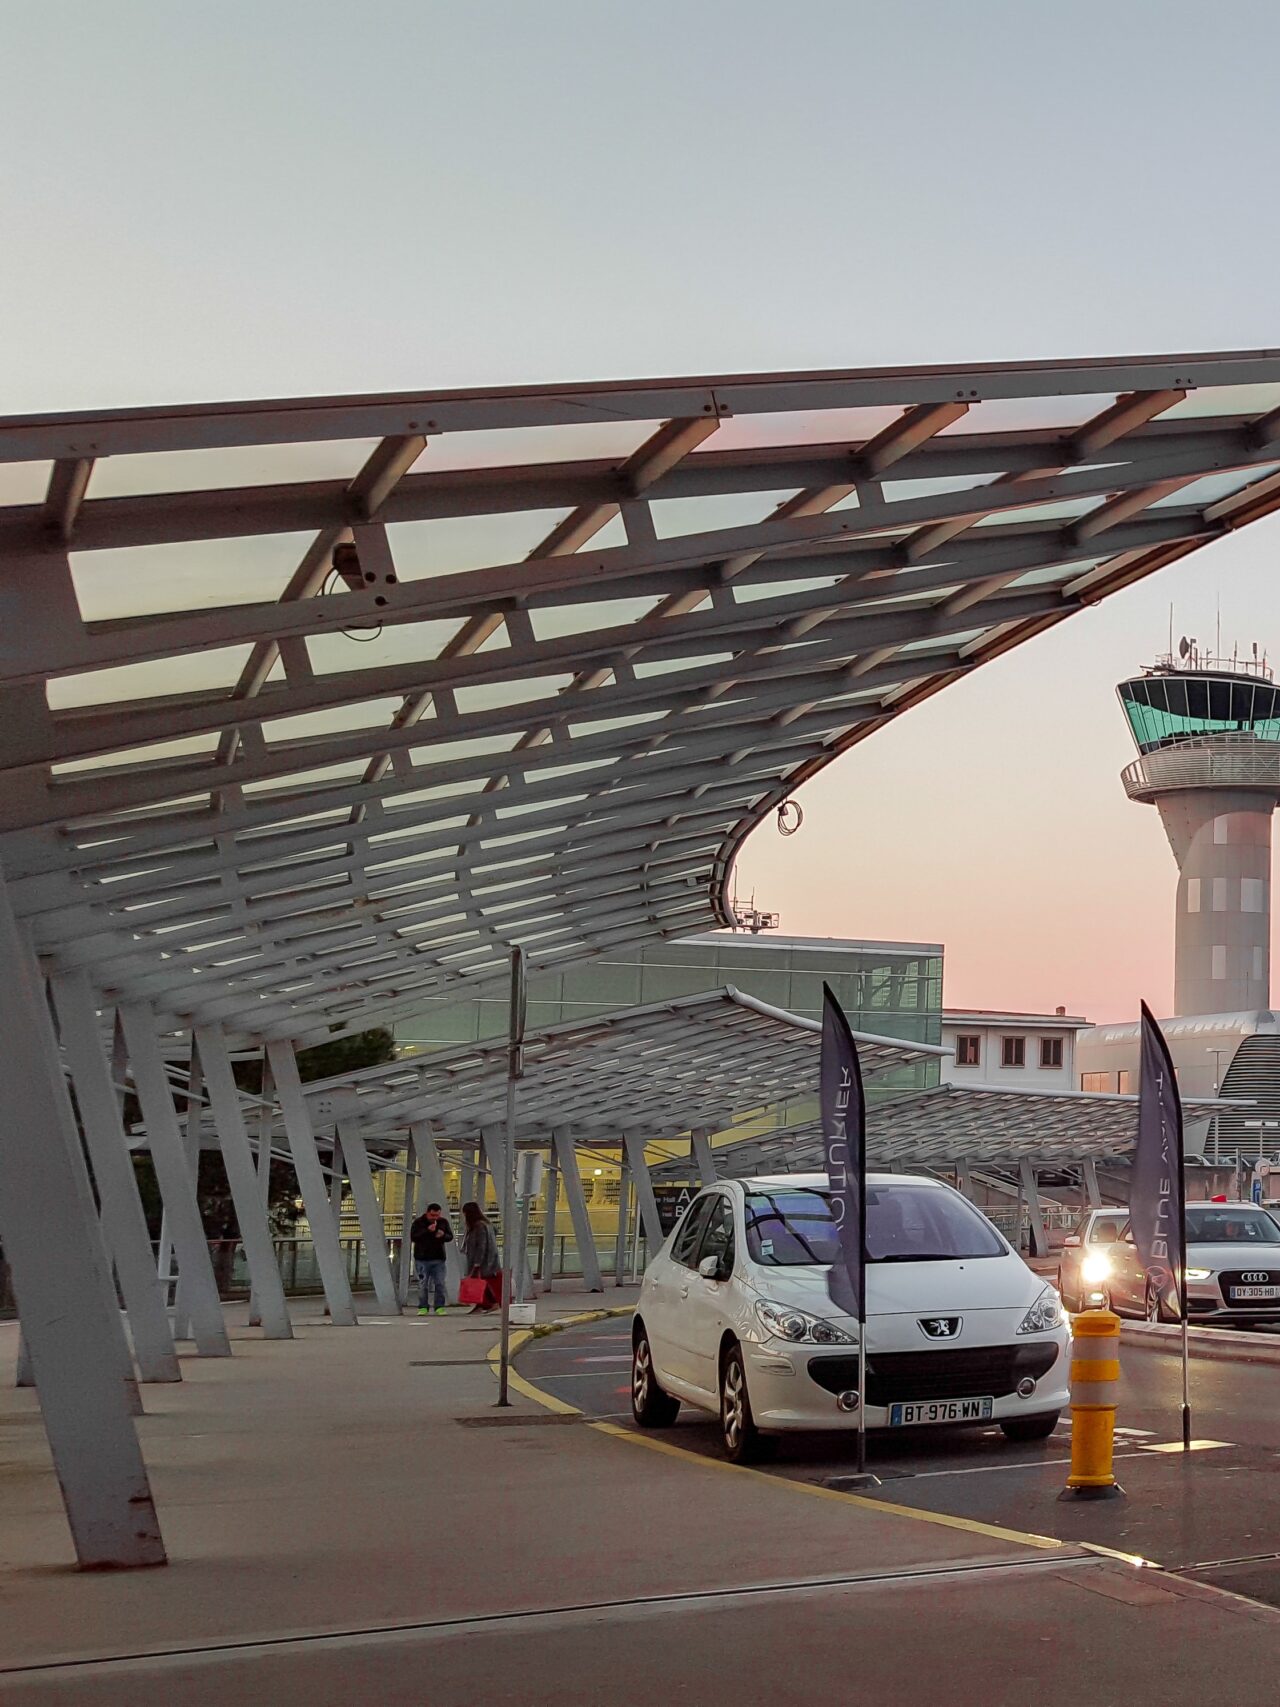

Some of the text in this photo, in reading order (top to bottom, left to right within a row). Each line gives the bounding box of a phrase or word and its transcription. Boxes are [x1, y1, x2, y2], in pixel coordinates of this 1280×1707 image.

[678, 1188, 690, 1203] A
[675, 1205, 685, 1218] B
[904, 1401, 980, 1423] BT-976-WN
